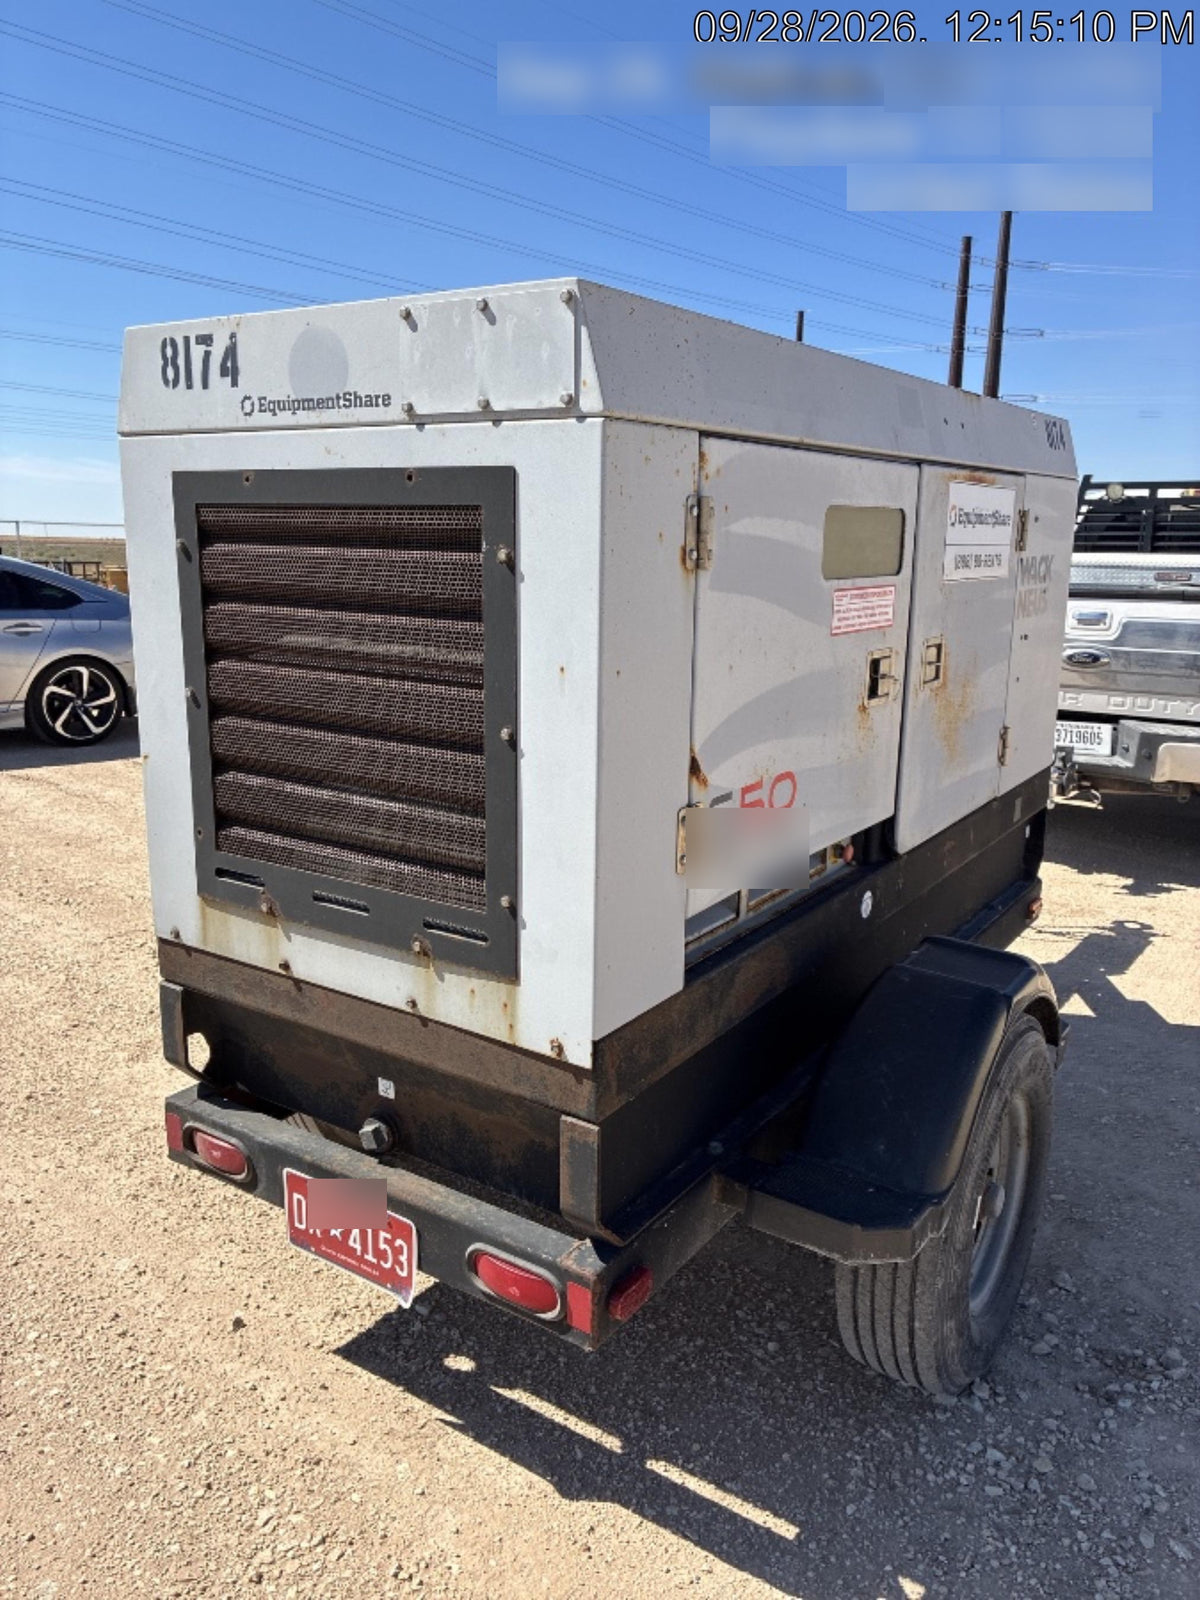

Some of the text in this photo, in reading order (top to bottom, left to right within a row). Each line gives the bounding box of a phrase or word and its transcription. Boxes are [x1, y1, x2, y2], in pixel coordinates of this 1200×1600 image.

[160, 332, 239, 390] 8174
[257, 391, 392, 415] EquipmentShare
[1106, 695, 1200, 717] DUTY
[1055, 728, 1104, 746] 3719605
